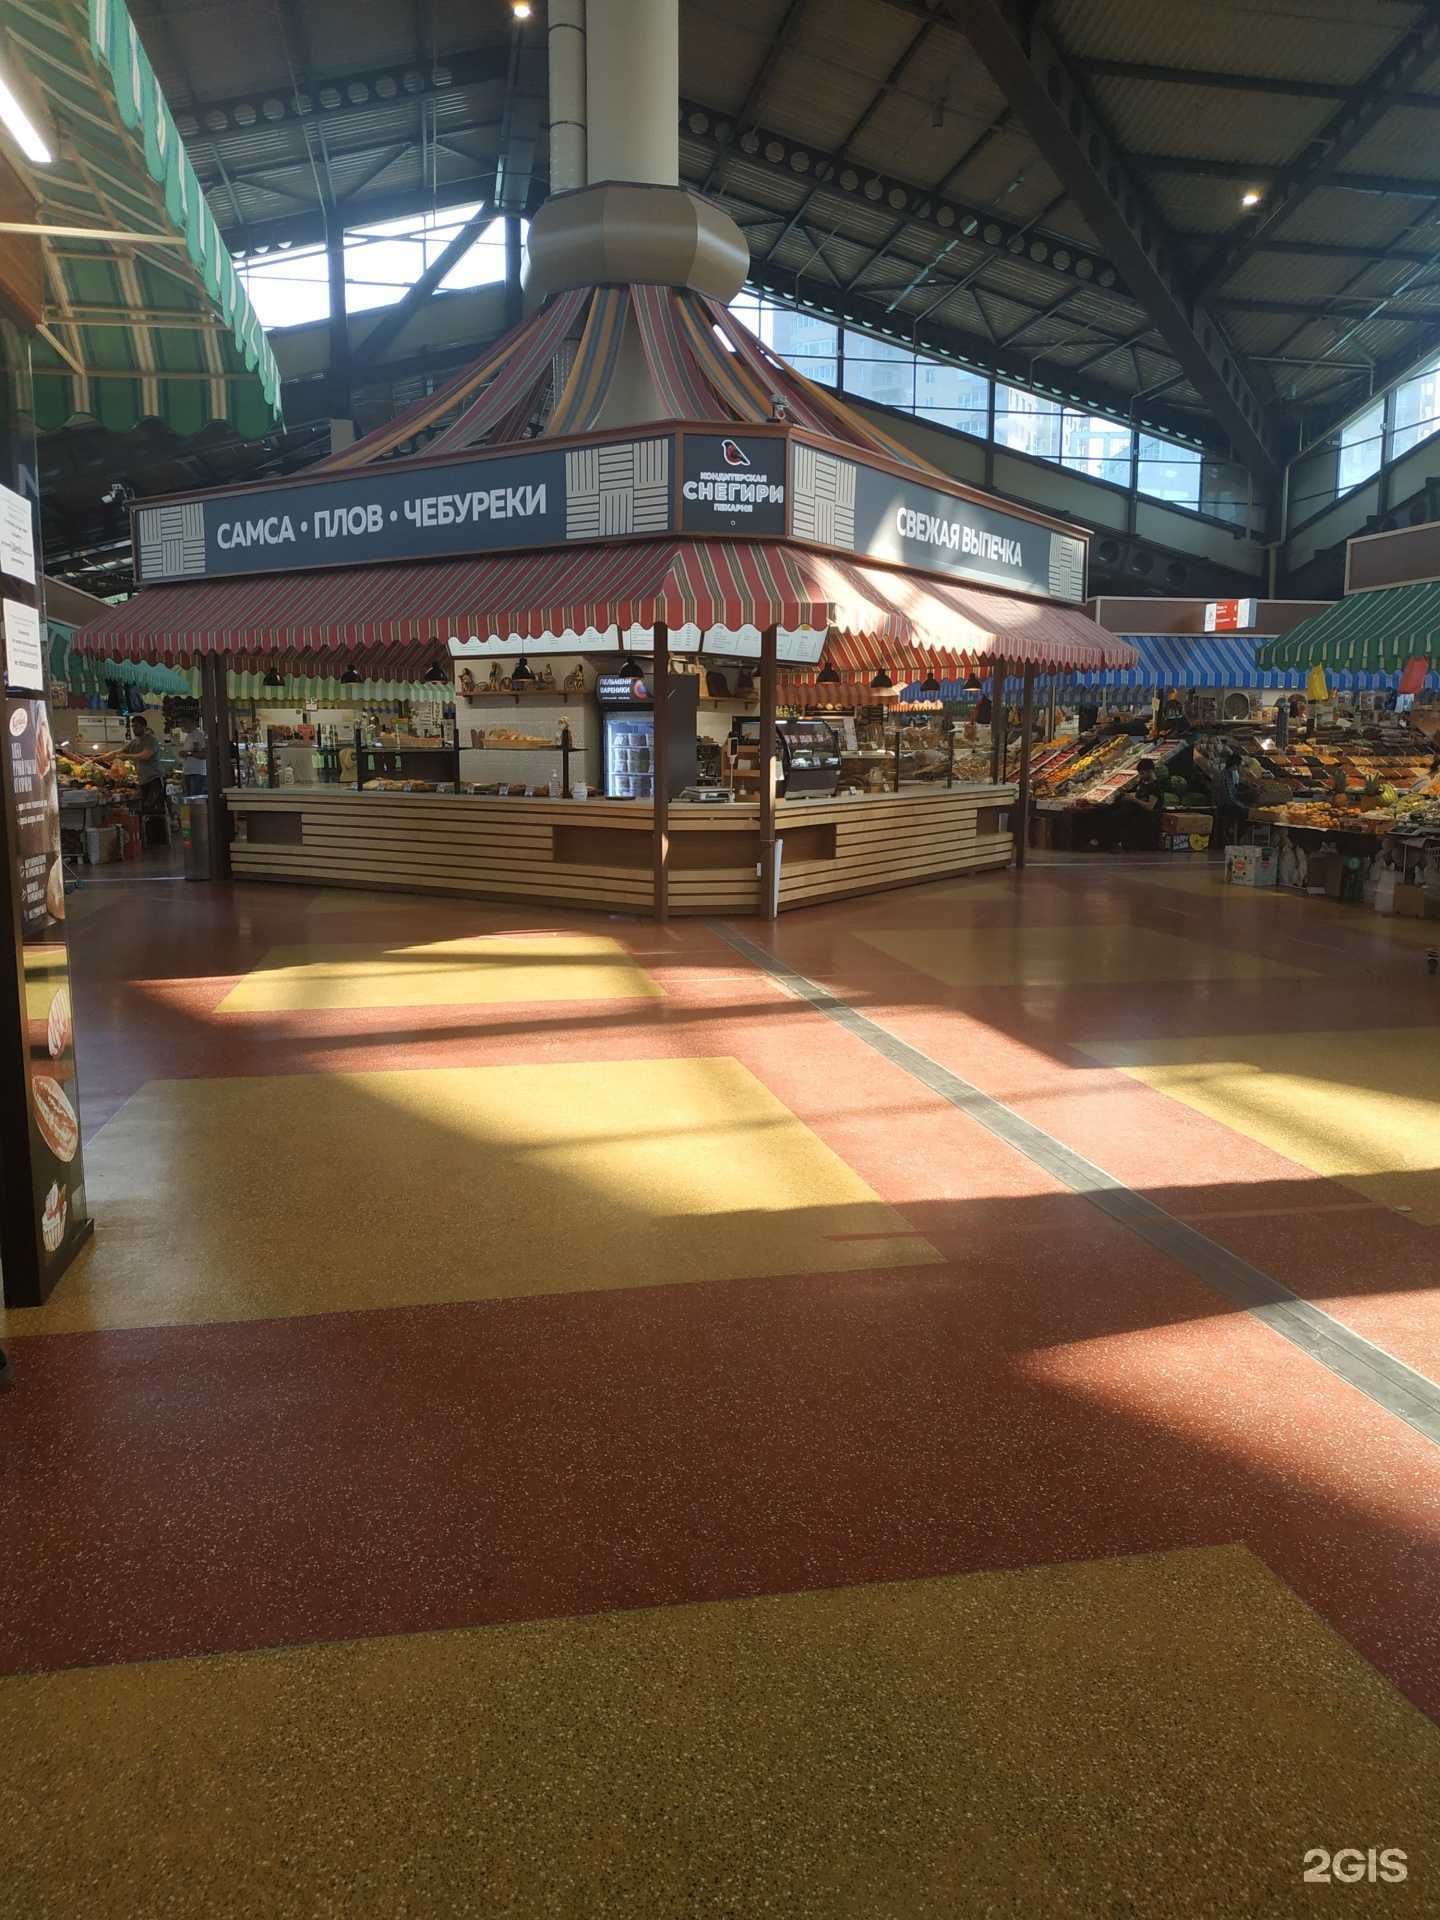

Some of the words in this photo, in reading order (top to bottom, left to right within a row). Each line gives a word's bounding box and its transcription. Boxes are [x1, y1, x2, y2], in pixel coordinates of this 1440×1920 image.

[700, 472, 767, 482] КОНДИТЕРСКАЯ
[683, 481, 784, 503] СНЕГИРИ
[217, 514, 295, 549] САМСА
[314, 504, 384, 539] ПЛОВ
[404, 483, 547, 527] ЧЕБУРЕКИ
[713, 503, 753, 512] ПЕКАРНЯ
[897, 507, 960, 550] СВЕЖАЯ
[961, 526, 1022, 567] ВЫПЕЧКА
